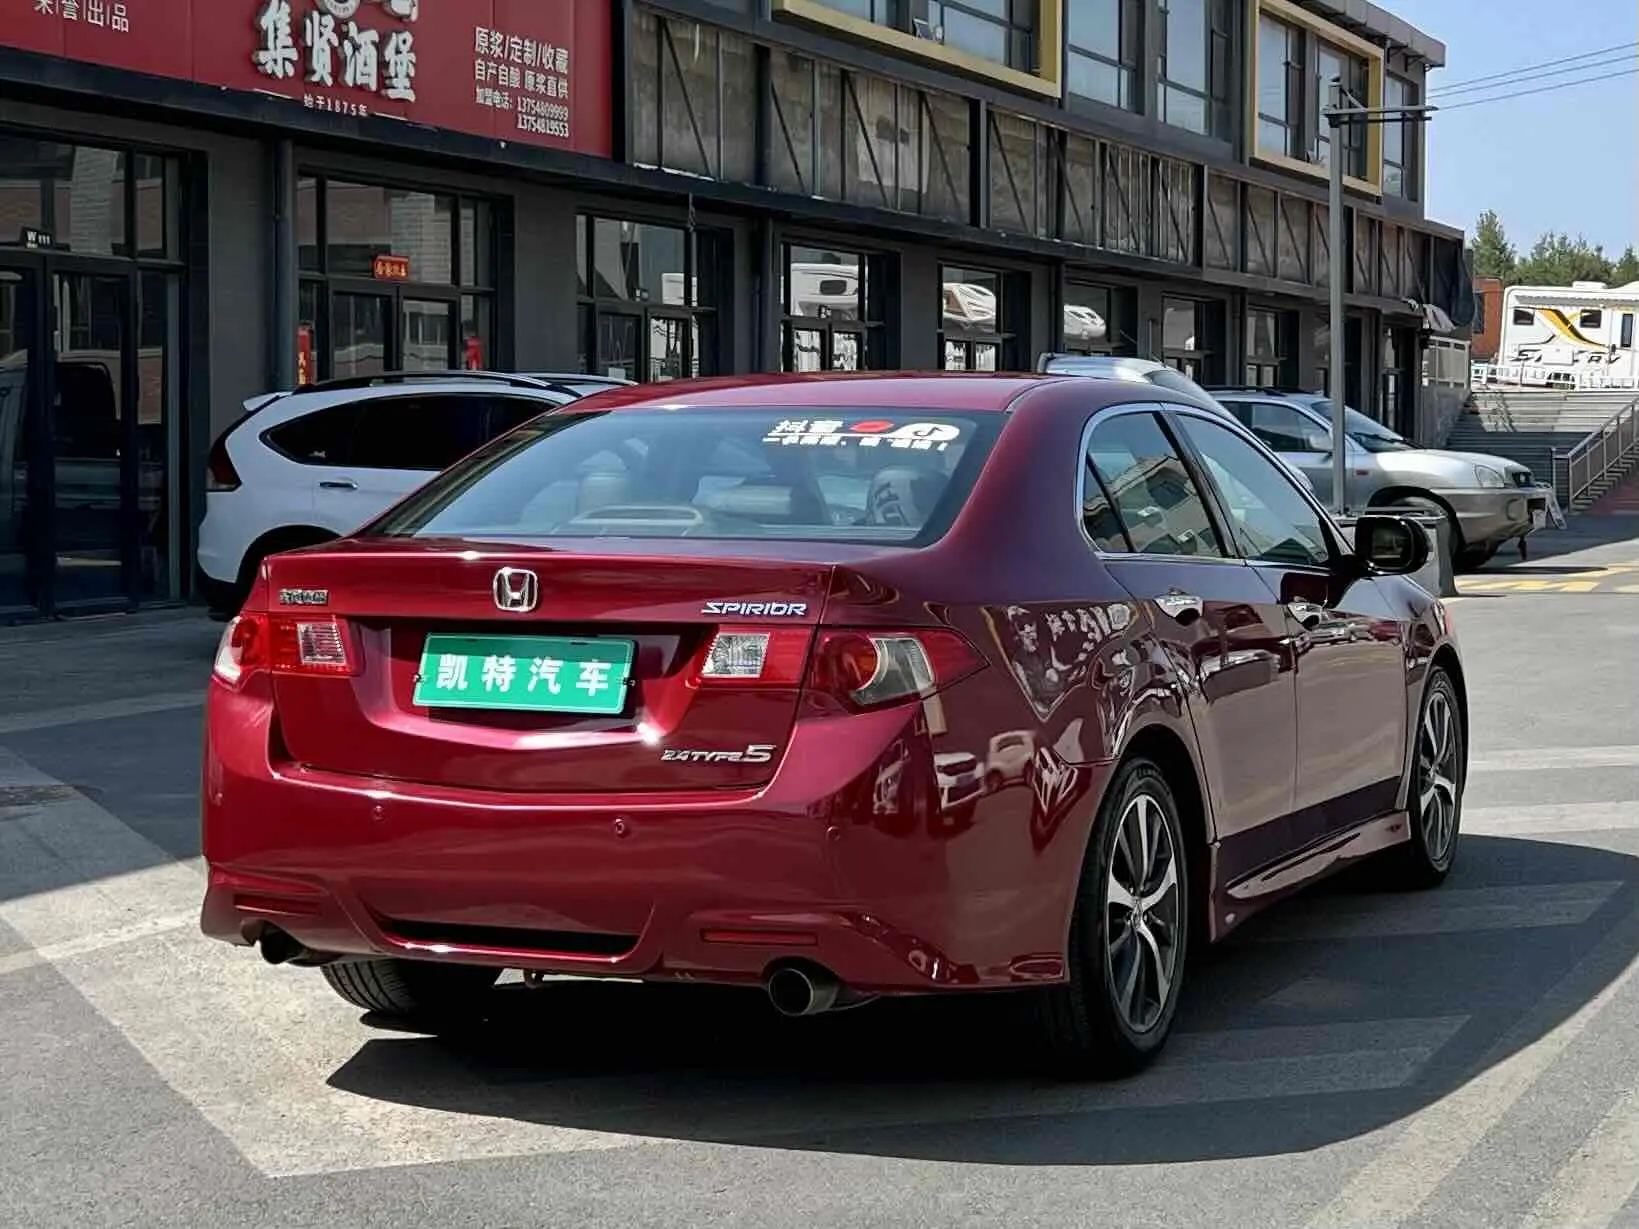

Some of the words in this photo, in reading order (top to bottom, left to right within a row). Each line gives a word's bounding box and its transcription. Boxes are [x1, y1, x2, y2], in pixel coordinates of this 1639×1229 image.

[259, 0, 417, 102] 集贤酒堡
[701, 602, 807, 616] SPIRIOR
[435, 653, 612, 697] 凯特汽车
